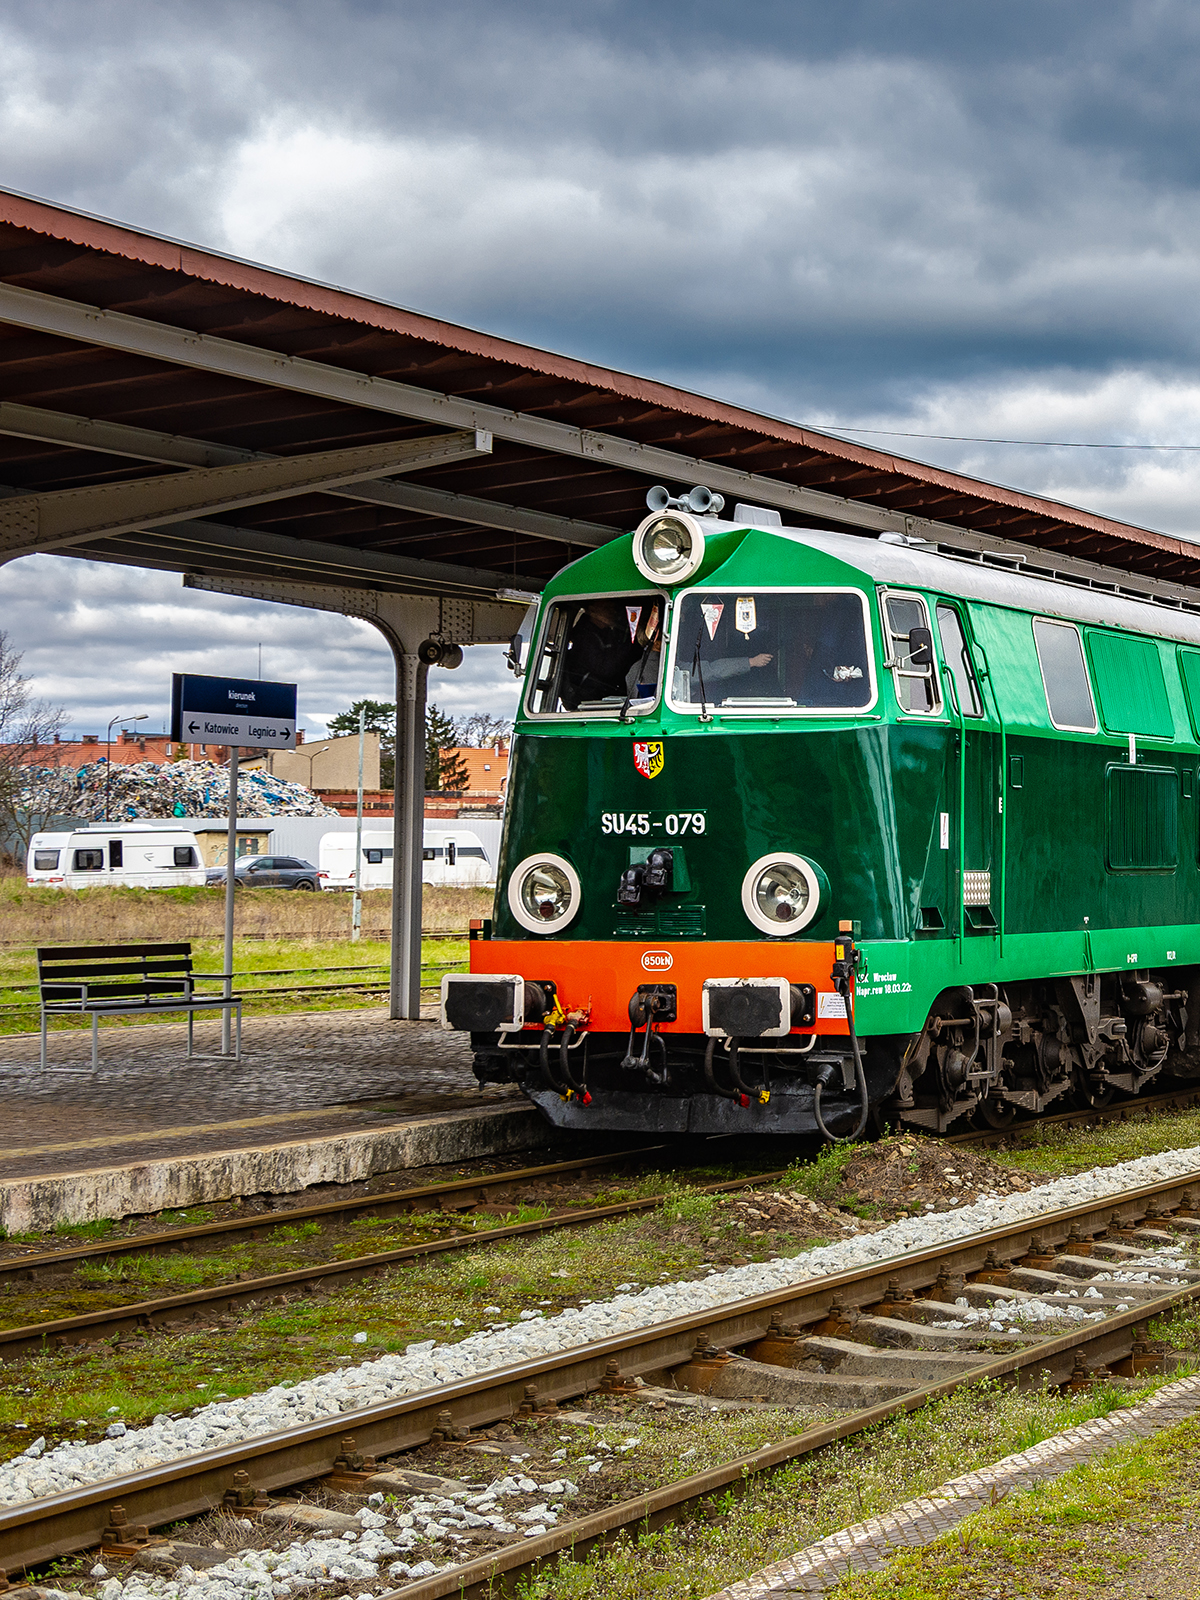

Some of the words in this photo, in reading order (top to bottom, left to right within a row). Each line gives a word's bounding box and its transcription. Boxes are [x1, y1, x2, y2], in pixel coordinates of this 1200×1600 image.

[228, 689, 256, 701] kierunek
[204, 721, 239, 735] Katowice
[248, 724, 277, 739] Legnica
[601, 813, 706, 836] SU45-079
[644, 955, 671, 966] 850kN
